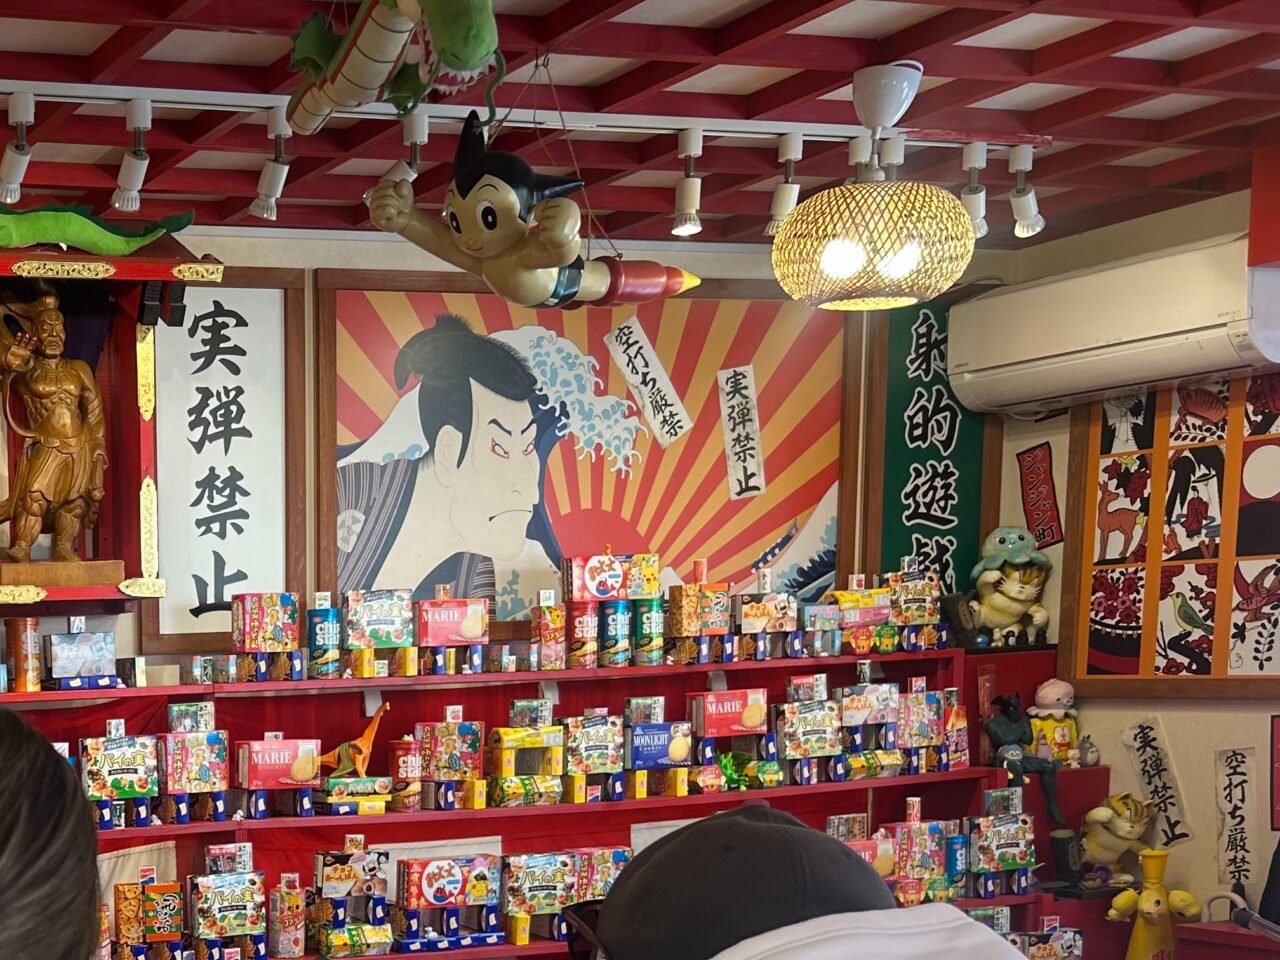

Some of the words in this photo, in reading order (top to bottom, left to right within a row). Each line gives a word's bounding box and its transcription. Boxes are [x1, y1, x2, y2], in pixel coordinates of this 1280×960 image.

[614, 325, 684, 440] 空打ち厳禁
[724, 369, 761, 497] 実弾禁止
[187, 300, 253, 618] 実弾禁止
[896, 582, 933, 598] パイの実
[361, 602, 403, 619] パイの実
[421, 610, 461, 623] MARIE
[642, 610, 664, 625] chi
[608, 611, 631, 627] chi
[608, 624, 631, 637] sta
[643, 621, 664, 634] sta
[706, 700, 743, 714] MARIE
[577, 729, 617, 745] パイの実
[633, 733, 669, 747] MOONLIGHT
[99, 750, 147, 769] パイの実
[251, 751, 293, 765] MARIE
[398, 754, 421, 770] chi
[398, 766, 421, 779] sta
[1132, 723, 1190, 849] 実弾禁止
[1223, 750, 1251, 882] 空打ち厳禁
[331, 864, 353, 875] チョコ
[522, 868, 566, 885] パイの実
[209, 888, 256, 906] パイの実
